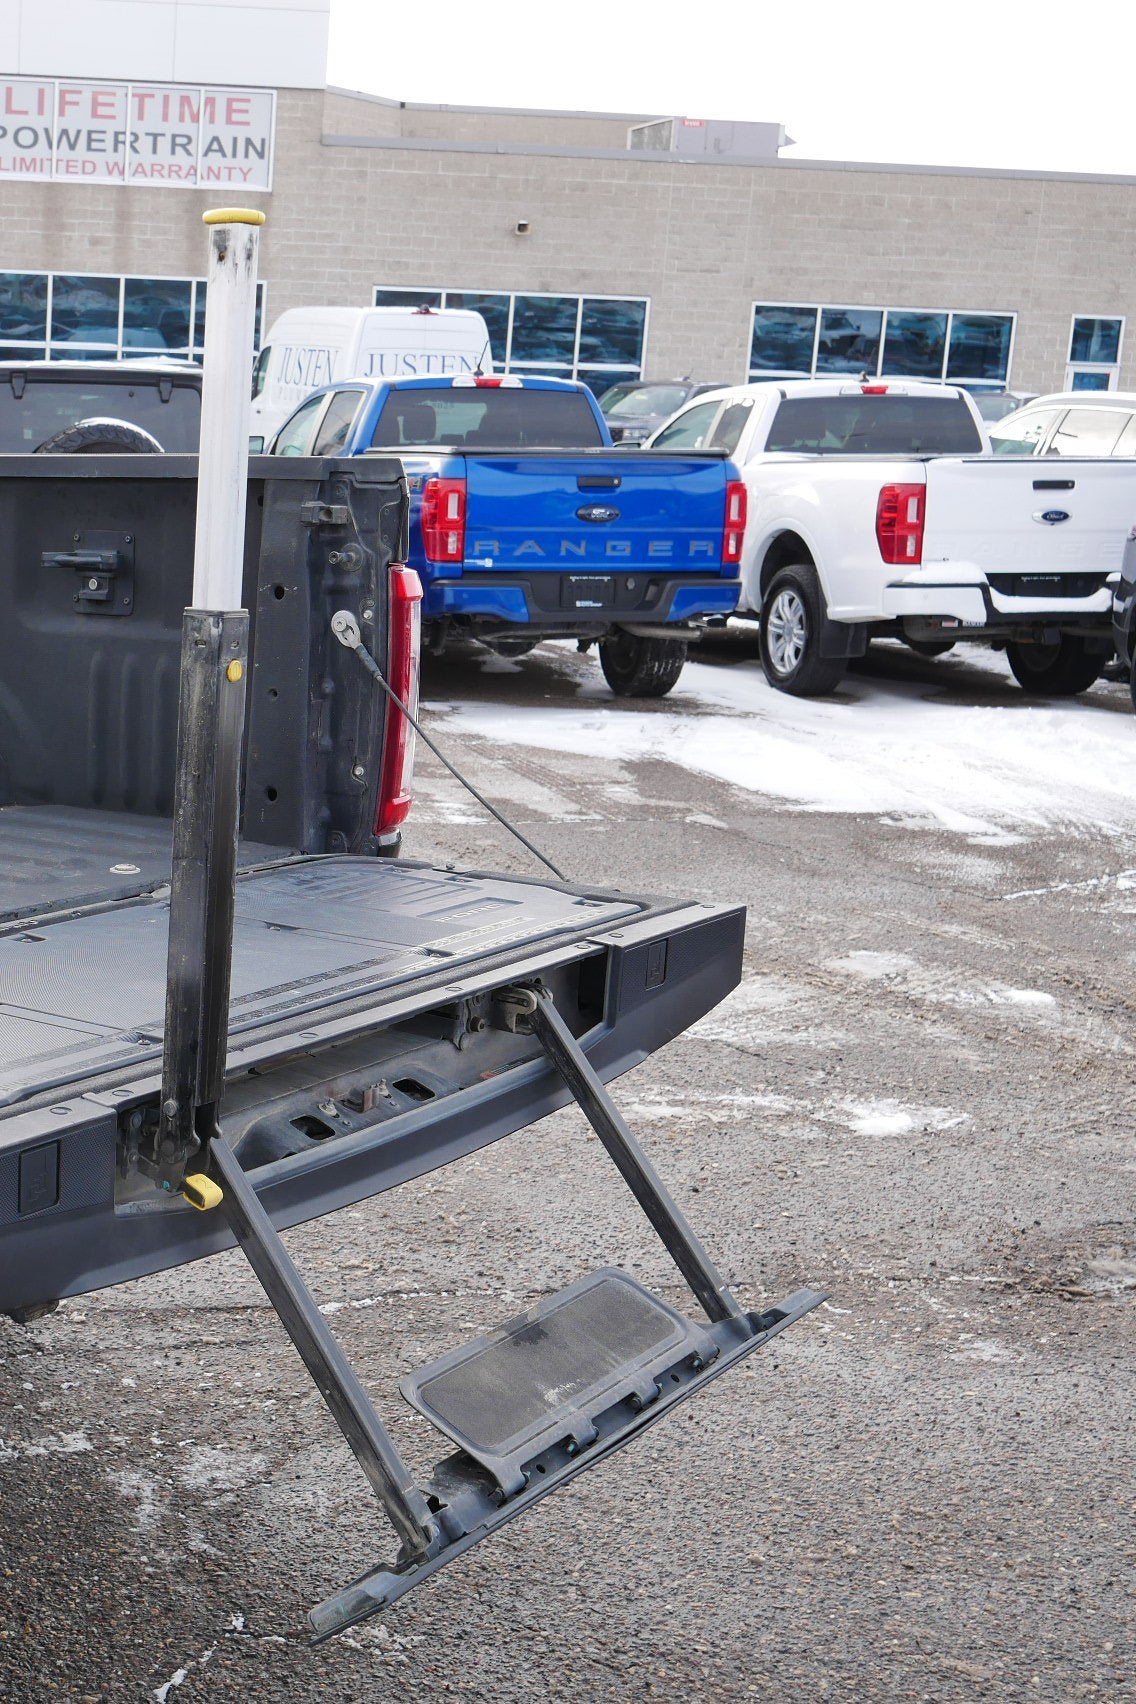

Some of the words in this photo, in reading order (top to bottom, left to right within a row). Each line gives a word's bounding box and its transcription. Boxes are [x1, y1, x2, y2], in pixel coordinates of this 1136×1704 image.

[5, 86, 252, 126] LIFETIME
[105, 161, 253, 182] WARRANTY
[277, 346, 339, 387] JUSTEN
[364, 352, 480, 377] JUSTEN
[472, 540, 714, 557] RANGER
